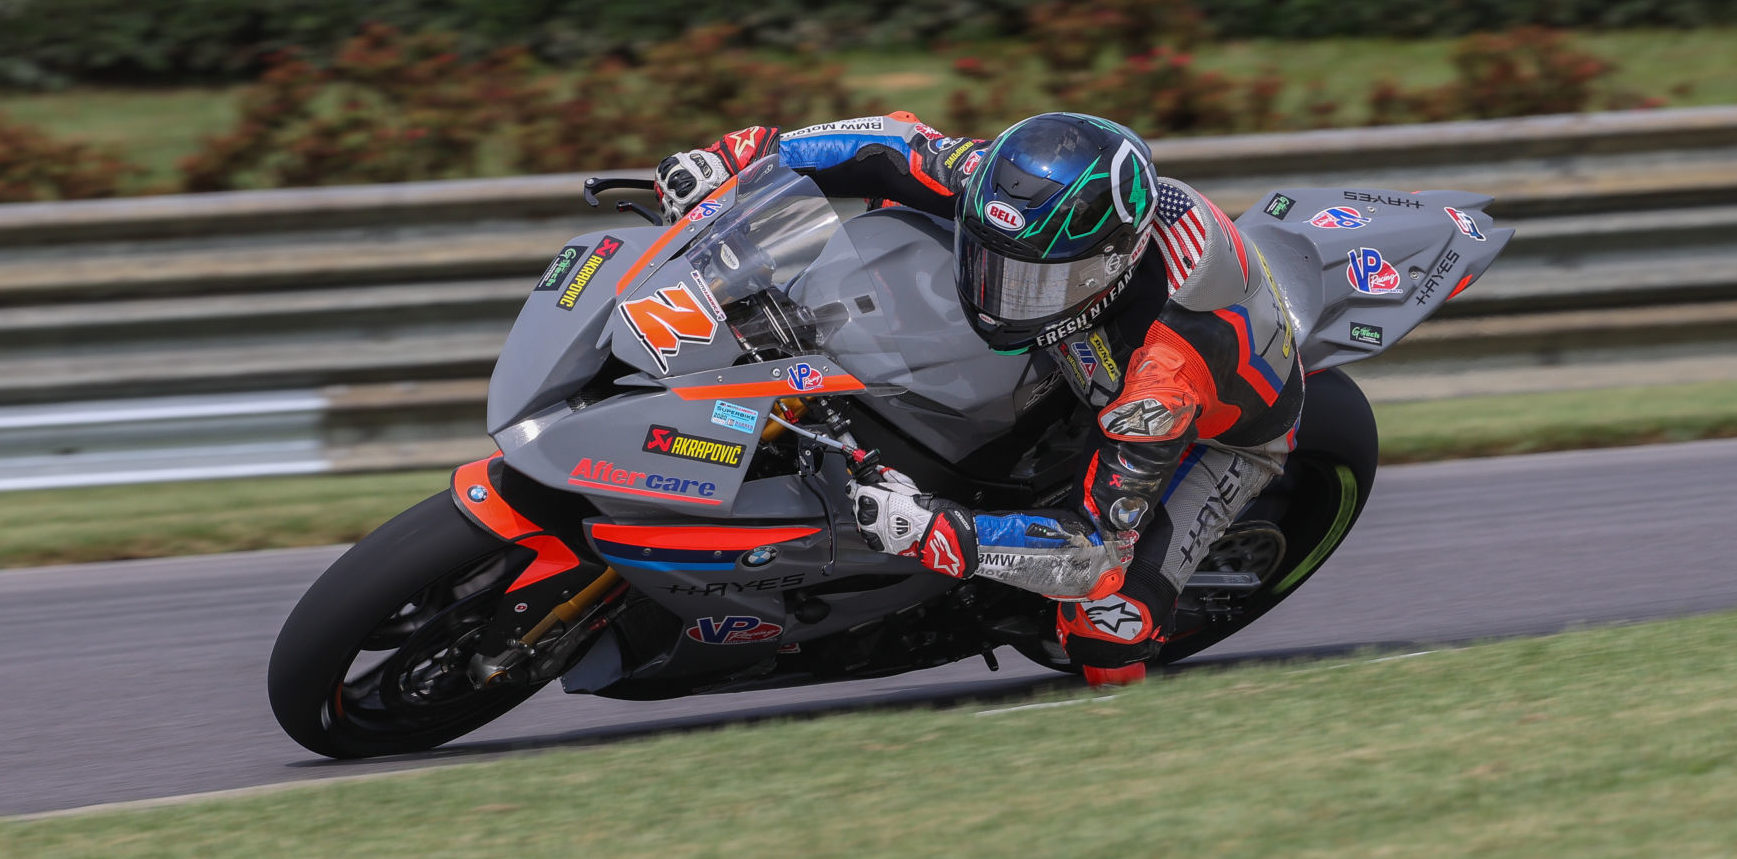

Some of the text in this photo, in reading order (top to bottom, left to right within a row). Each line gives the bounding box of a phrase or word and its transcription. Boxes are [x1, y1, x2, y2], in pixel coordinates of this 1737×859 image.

[841, 122, 882, 130] BMW
[1344, 191, 1425, 209] HAYES
[990, 205, 1018, 227] BELL
[1348, 247, 1382, 293] VP
[1370, 272, 1397, 287] Racing
[1416, 249, 1460, 306] HAYES
[1036, 312, 1088, 348] FRESH
[1090, 306, 1101, 318] N
[787, 363, 811, 390] VP
[656, 573, 806, 597] HAYES
[697, 616, 761, 645] VP
